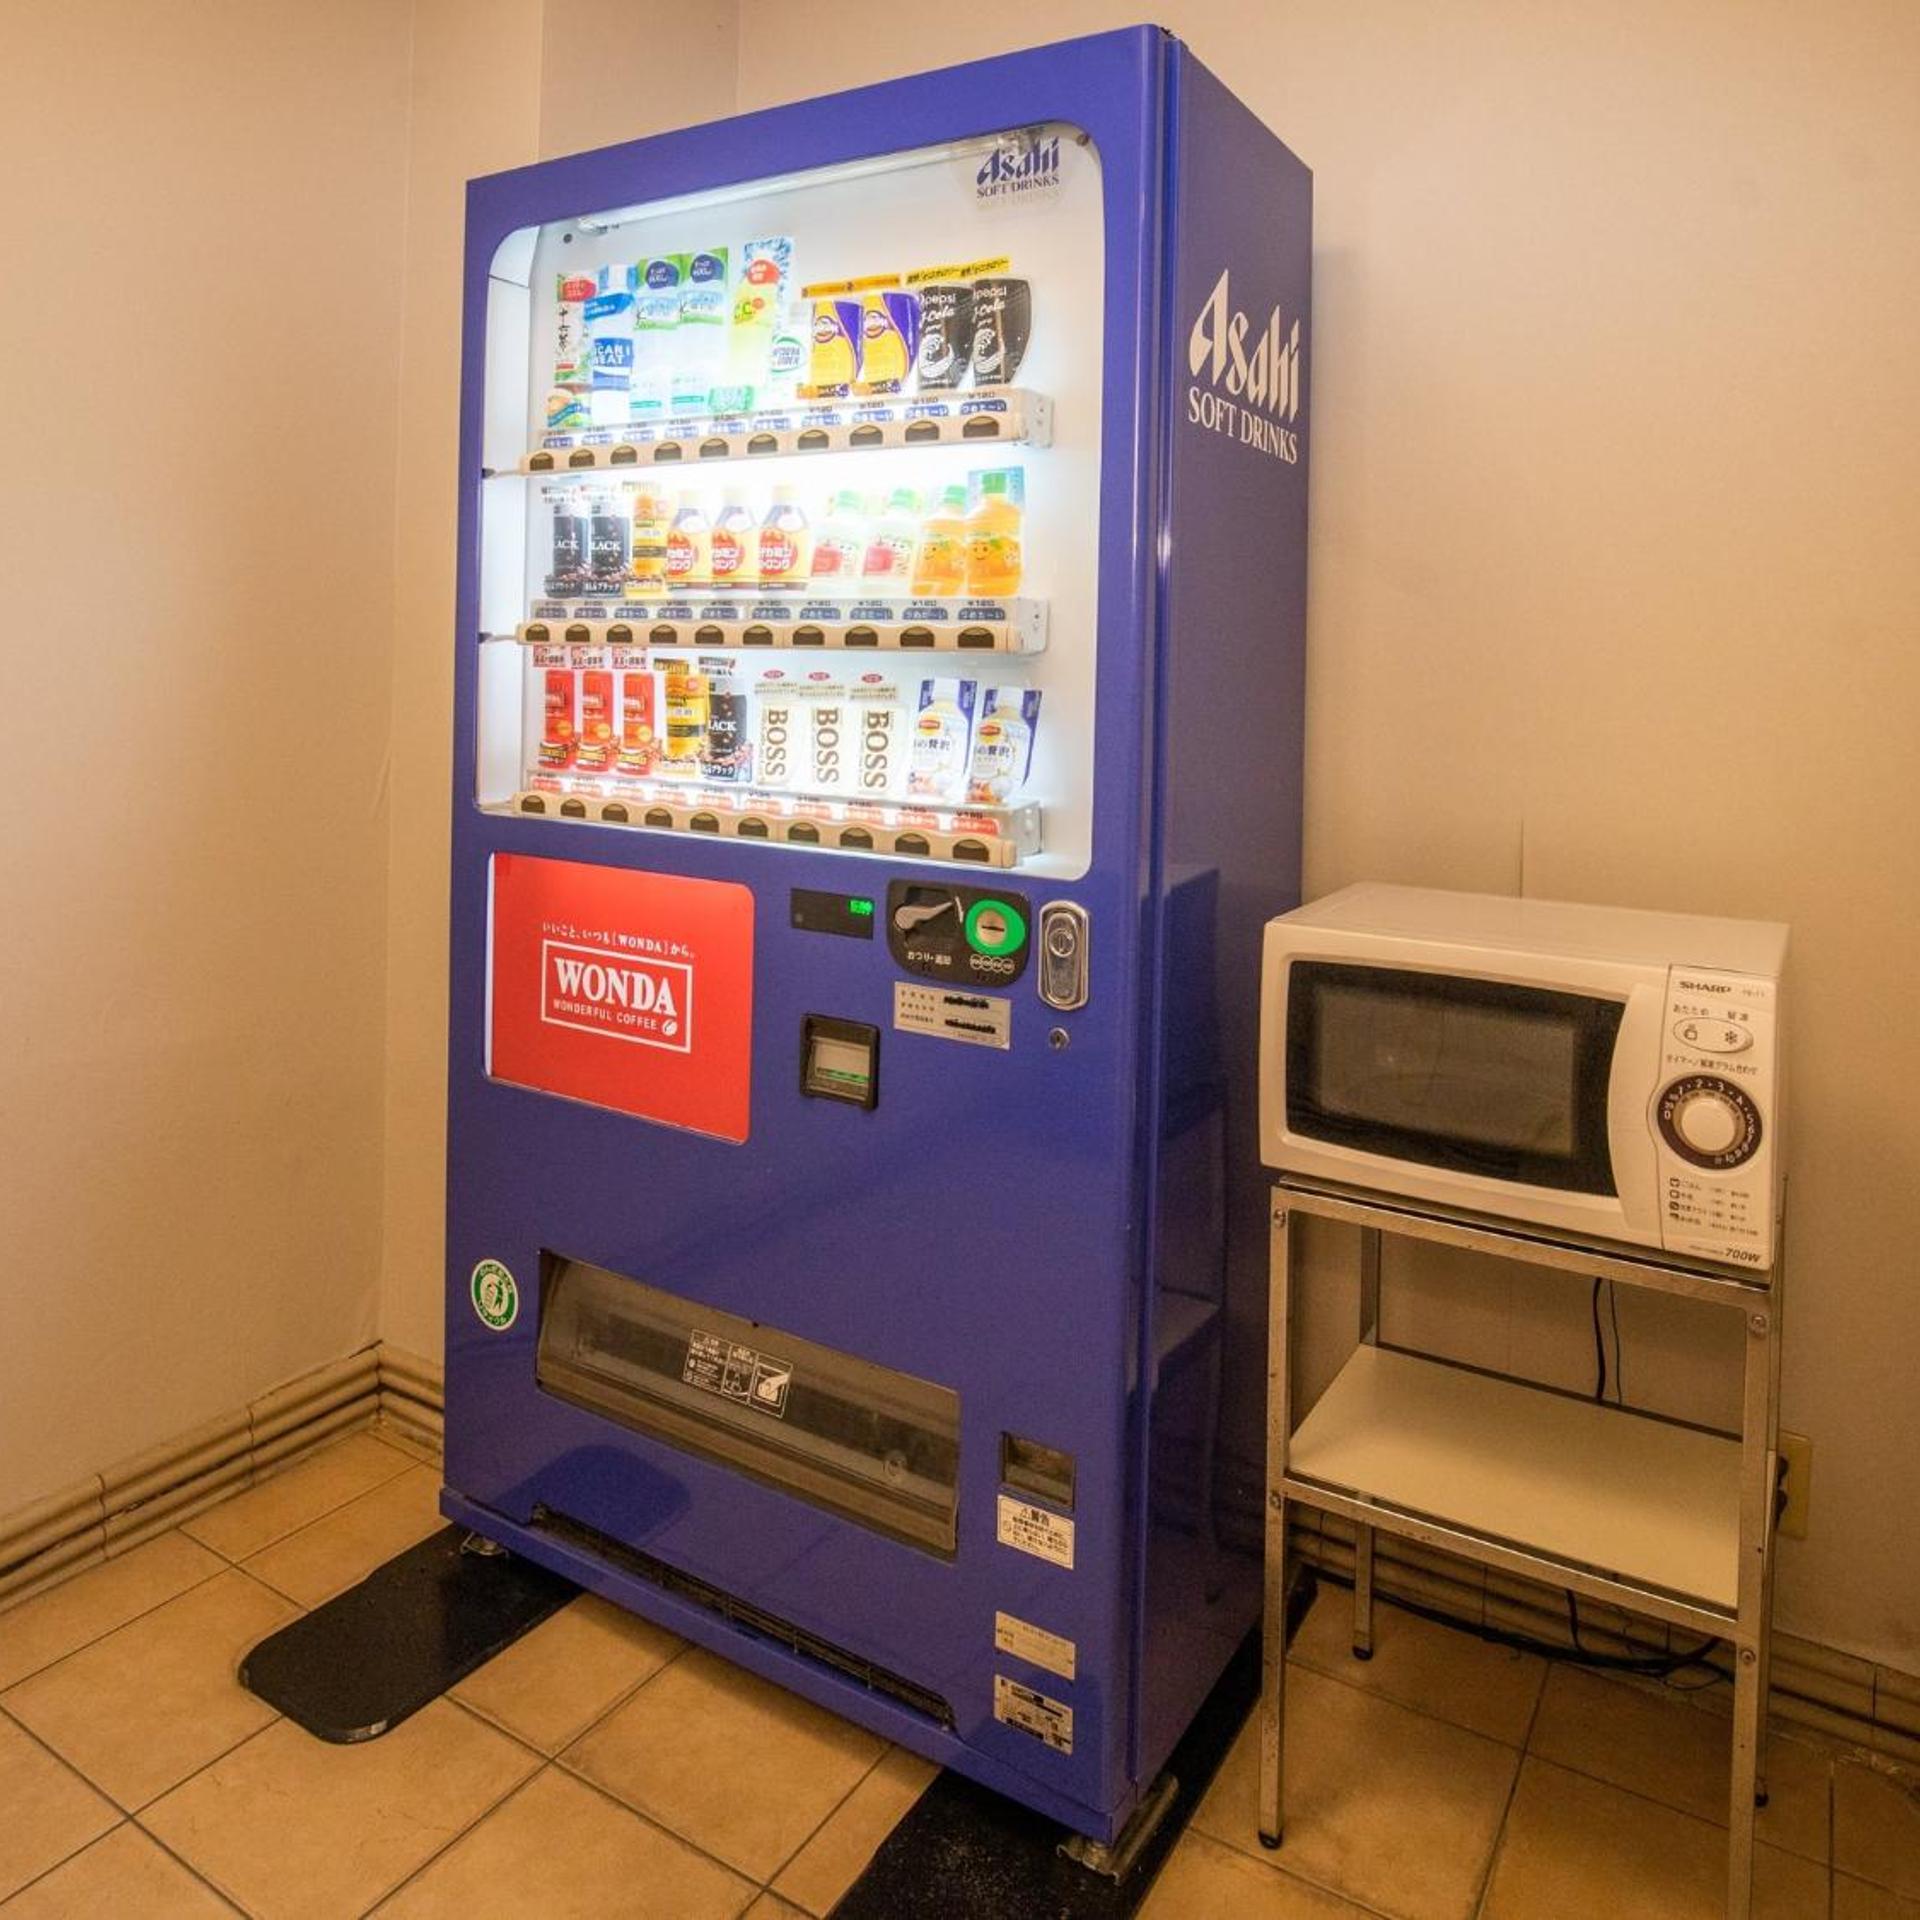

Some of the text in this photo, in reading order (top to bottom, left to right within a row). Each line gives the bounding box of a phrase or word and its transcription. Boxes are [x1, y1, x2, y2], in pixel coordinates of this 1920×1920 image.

[976, 176, 1060, 198] SOFT DRINKS
[977, 136, 1060, 185] Asahi
[1189, 268, 1300, 423] Asahi
[1189, 386, 1298, 465] SOFT DRINKS
[765, 708, 789, 777] BOSS
[816, 706, 840, 784] BOSS
[863, 710, 889, 789] BOSS
[553, 998, 657, 1031] WONDERFUL COFFEE
[554, 957, 678, 1017] WONDA
[1680, 981, 1732, 994] SHARP
[1724, 1247, 1761, 1263] 700W
